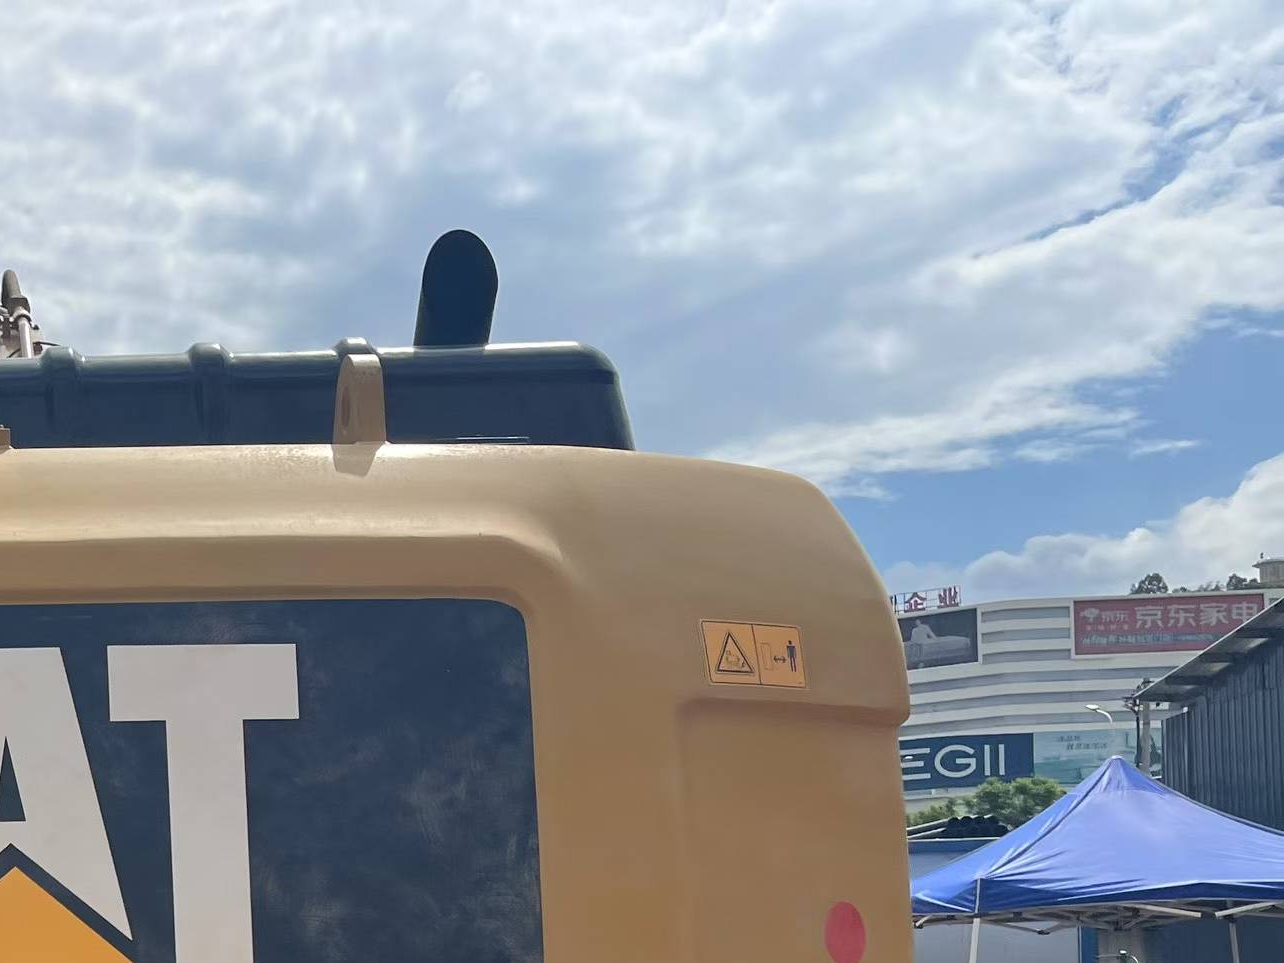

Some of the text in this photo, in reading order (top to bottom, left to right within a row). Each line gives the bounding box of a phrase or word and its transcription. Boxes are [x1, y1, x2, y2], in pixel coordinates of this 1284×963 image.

[890, 585, 959, 613] 企业
[1134, 601, 1259, 629] 京东家电
